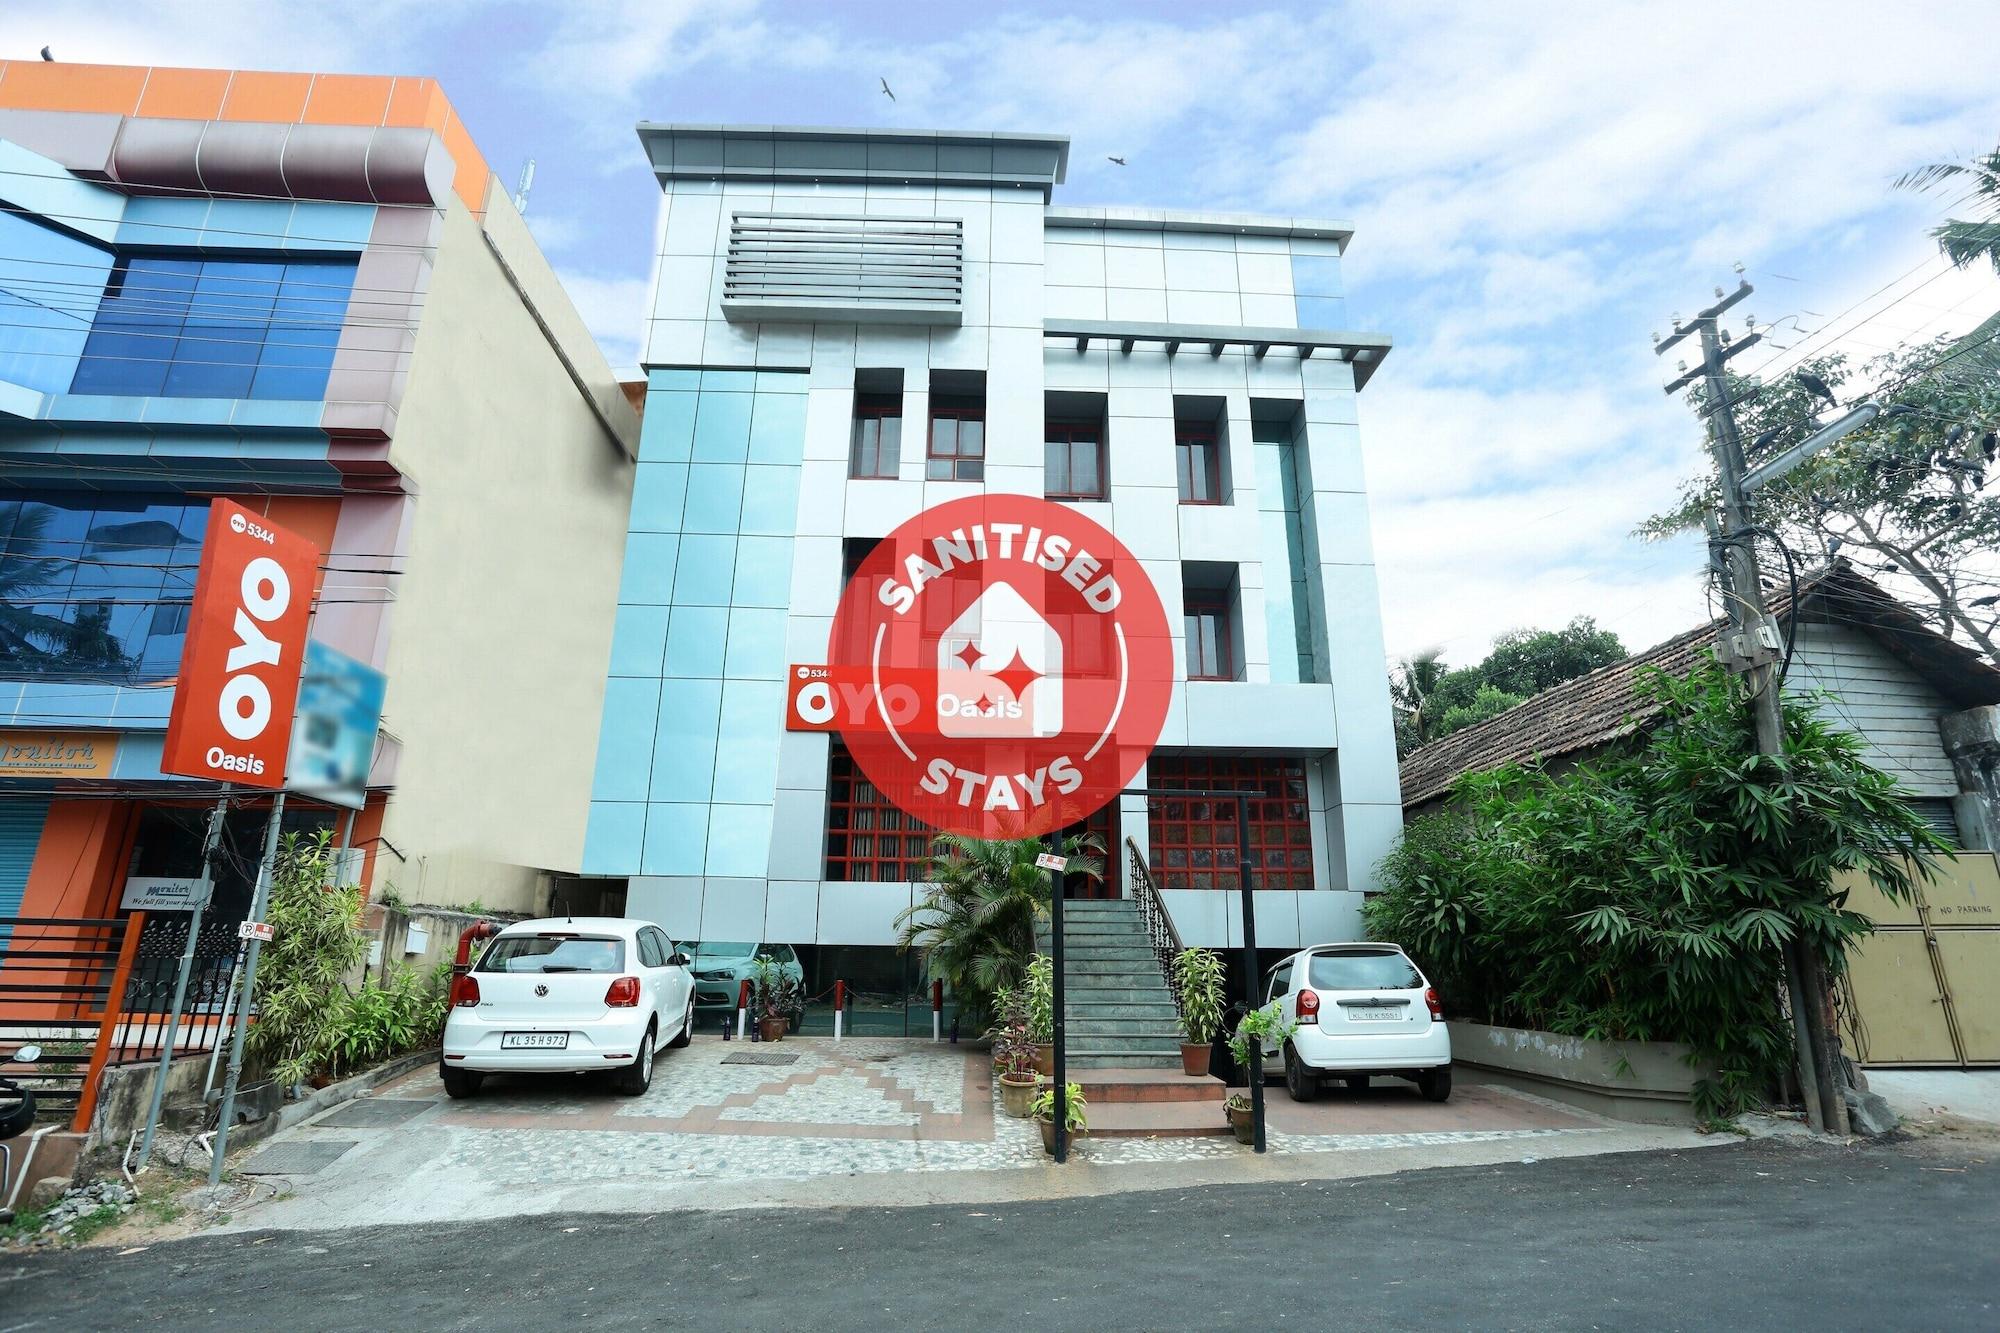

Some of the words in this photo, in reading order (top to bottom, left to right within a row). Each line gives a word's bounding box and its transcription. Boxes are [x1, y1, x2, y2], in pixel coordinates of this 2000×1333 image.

[247, 522, 275, 544] 5344
[219, 557, 291, 740] OYO
[796, 681, 921, 726] OYO
[936, 693, 1023, 719] Oasis
[205, 746, 265, 776] Oasis
[1940, 906, 1952, 915] NO
[1957, 905, 1992, 914] PARKING
[509, 1035, 522, 1046] KL
[523, 1035, 537, 1046] 35
[537, 1035, 545, 1046] H
[546, 1035, 565, 1046] 972
